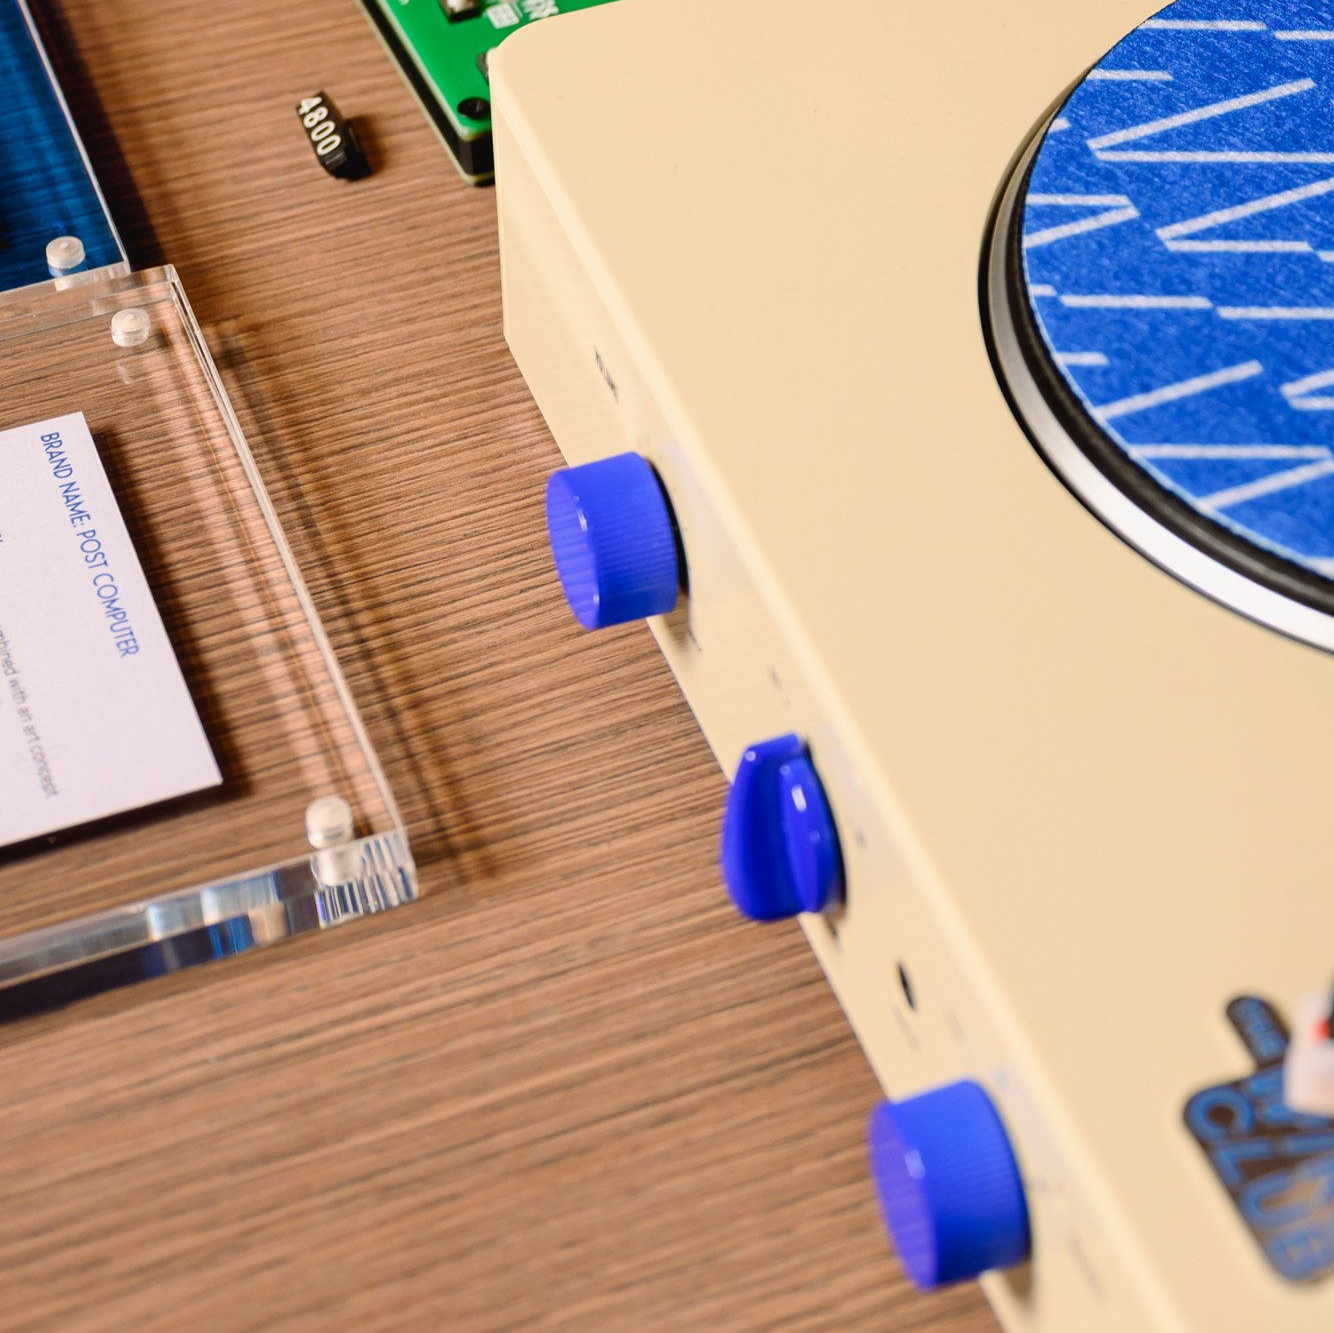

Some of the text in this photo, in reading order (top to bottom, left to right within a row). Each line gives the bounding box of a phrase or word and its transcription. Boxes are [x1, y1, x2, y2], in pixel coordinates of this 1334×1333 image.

[298, 96, 342, 156] 4800
[40, 431, 140, 658] BRAND NAME: POST COMPUTER
